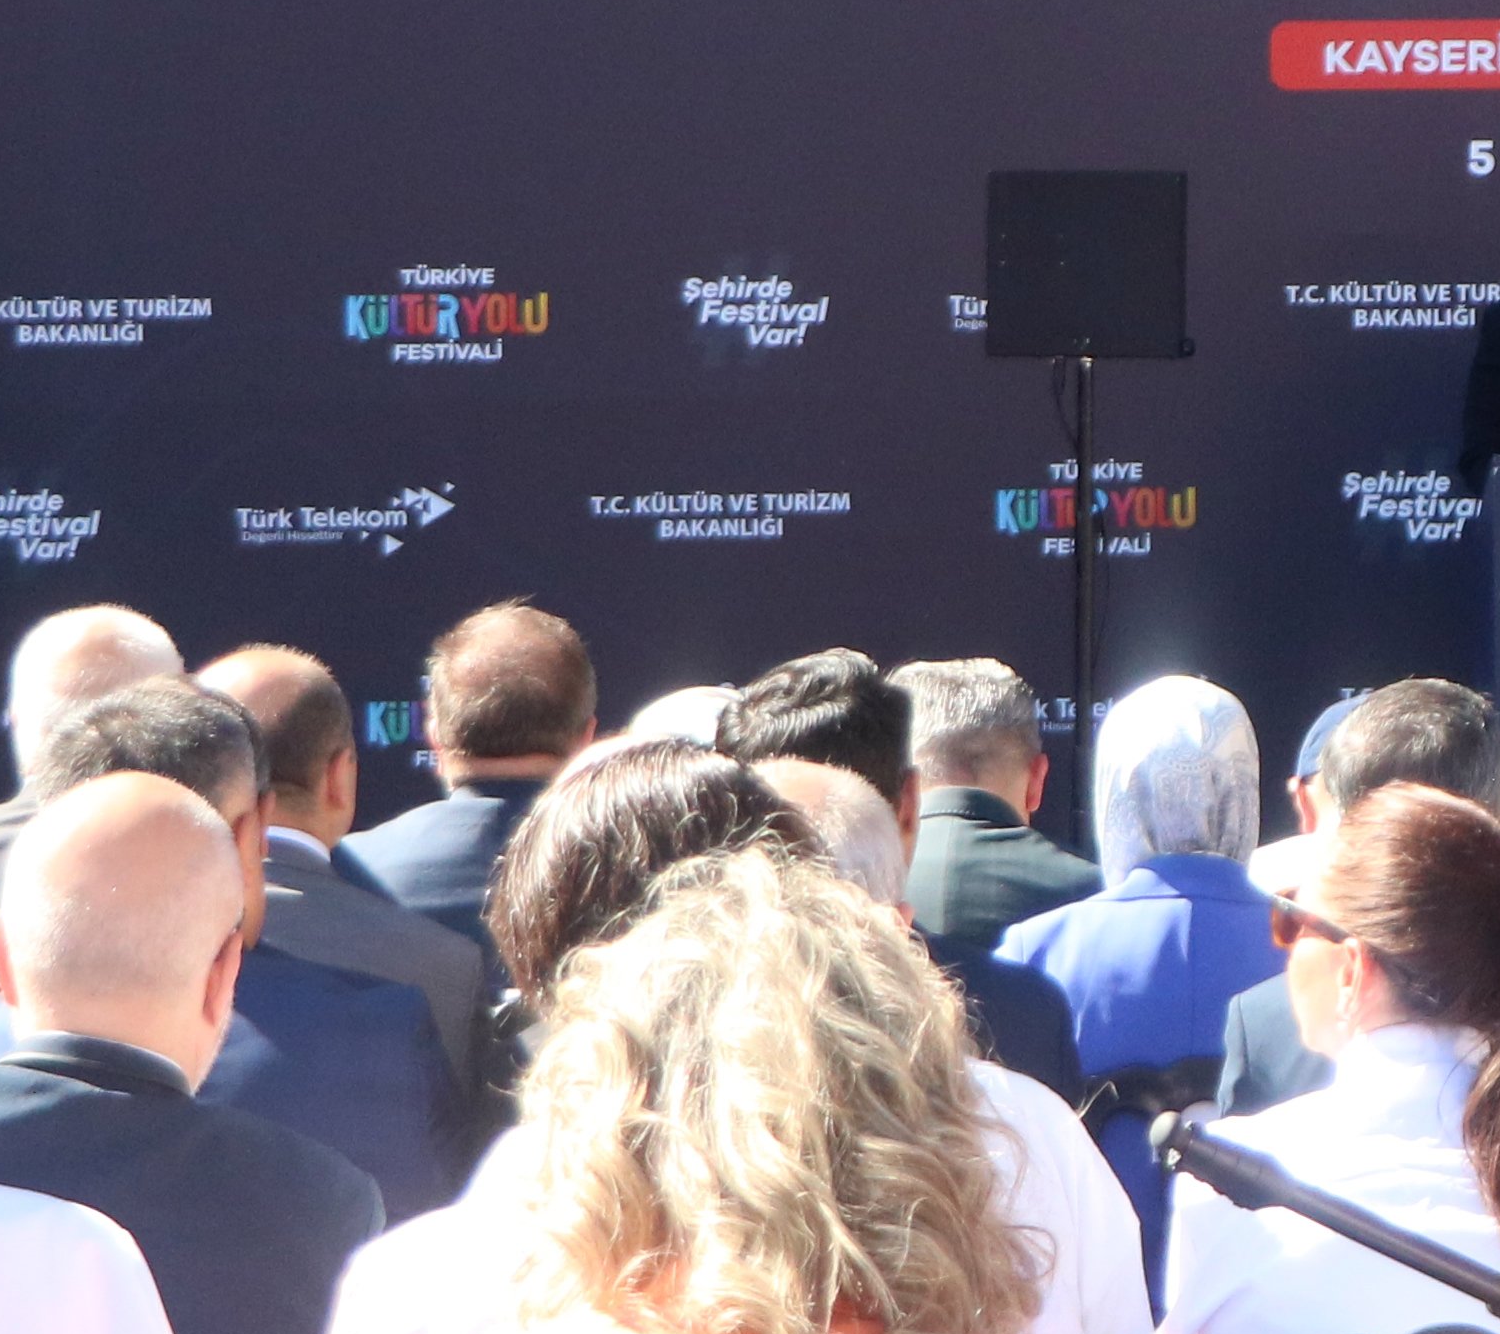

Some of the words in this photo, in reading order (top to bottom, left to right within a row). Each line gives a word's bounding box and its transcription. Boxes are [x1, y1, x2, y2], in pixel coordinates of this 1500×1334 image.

[1468, 140, 1495, 175] 5
[402, 265, 494, 286] TÜRKİYE
[684, 277, 792, 303] Şehirde
[1287, 286, 1325, 305] T.C.
[1330, 283, 1418, 304] KÜLTÜR
[1422, 285, 1452, 303] VE
[89, 301, 118, 318] VE
[124, 296, 211, 318] TURİZM
[701, 297, 828, 323] Festival
[950, 295, 988, 316] Tür
[1354, 305, 1476, 328] BAKANLIĞI
[18, 322, 144, 343] BAKANLIĞI
[749, 323, 806, 345] Var!
[394, 338, 502, 361] FESTİVALİ
[1051, 459, 1142, 480] TÜKİYE
[1344, 472, 1450, 498] Şehirde
[592, 496, 630, 515] T.C.
[636, 492, 724, 514] KÜLTÜR
[729, 495, 759, 512] VE
[764, 489, 850, 512] TURİZM
[996, 488, 1109, 533] KÜLT
[237, 508, 292, 529] Türk
[300, 506, 407, 528] Telekom
[660, 515, 783, 538] BAKANLIĞI
[1407, 519, 1464, 541] Var!
[19, 537, 79, 559] Var!
